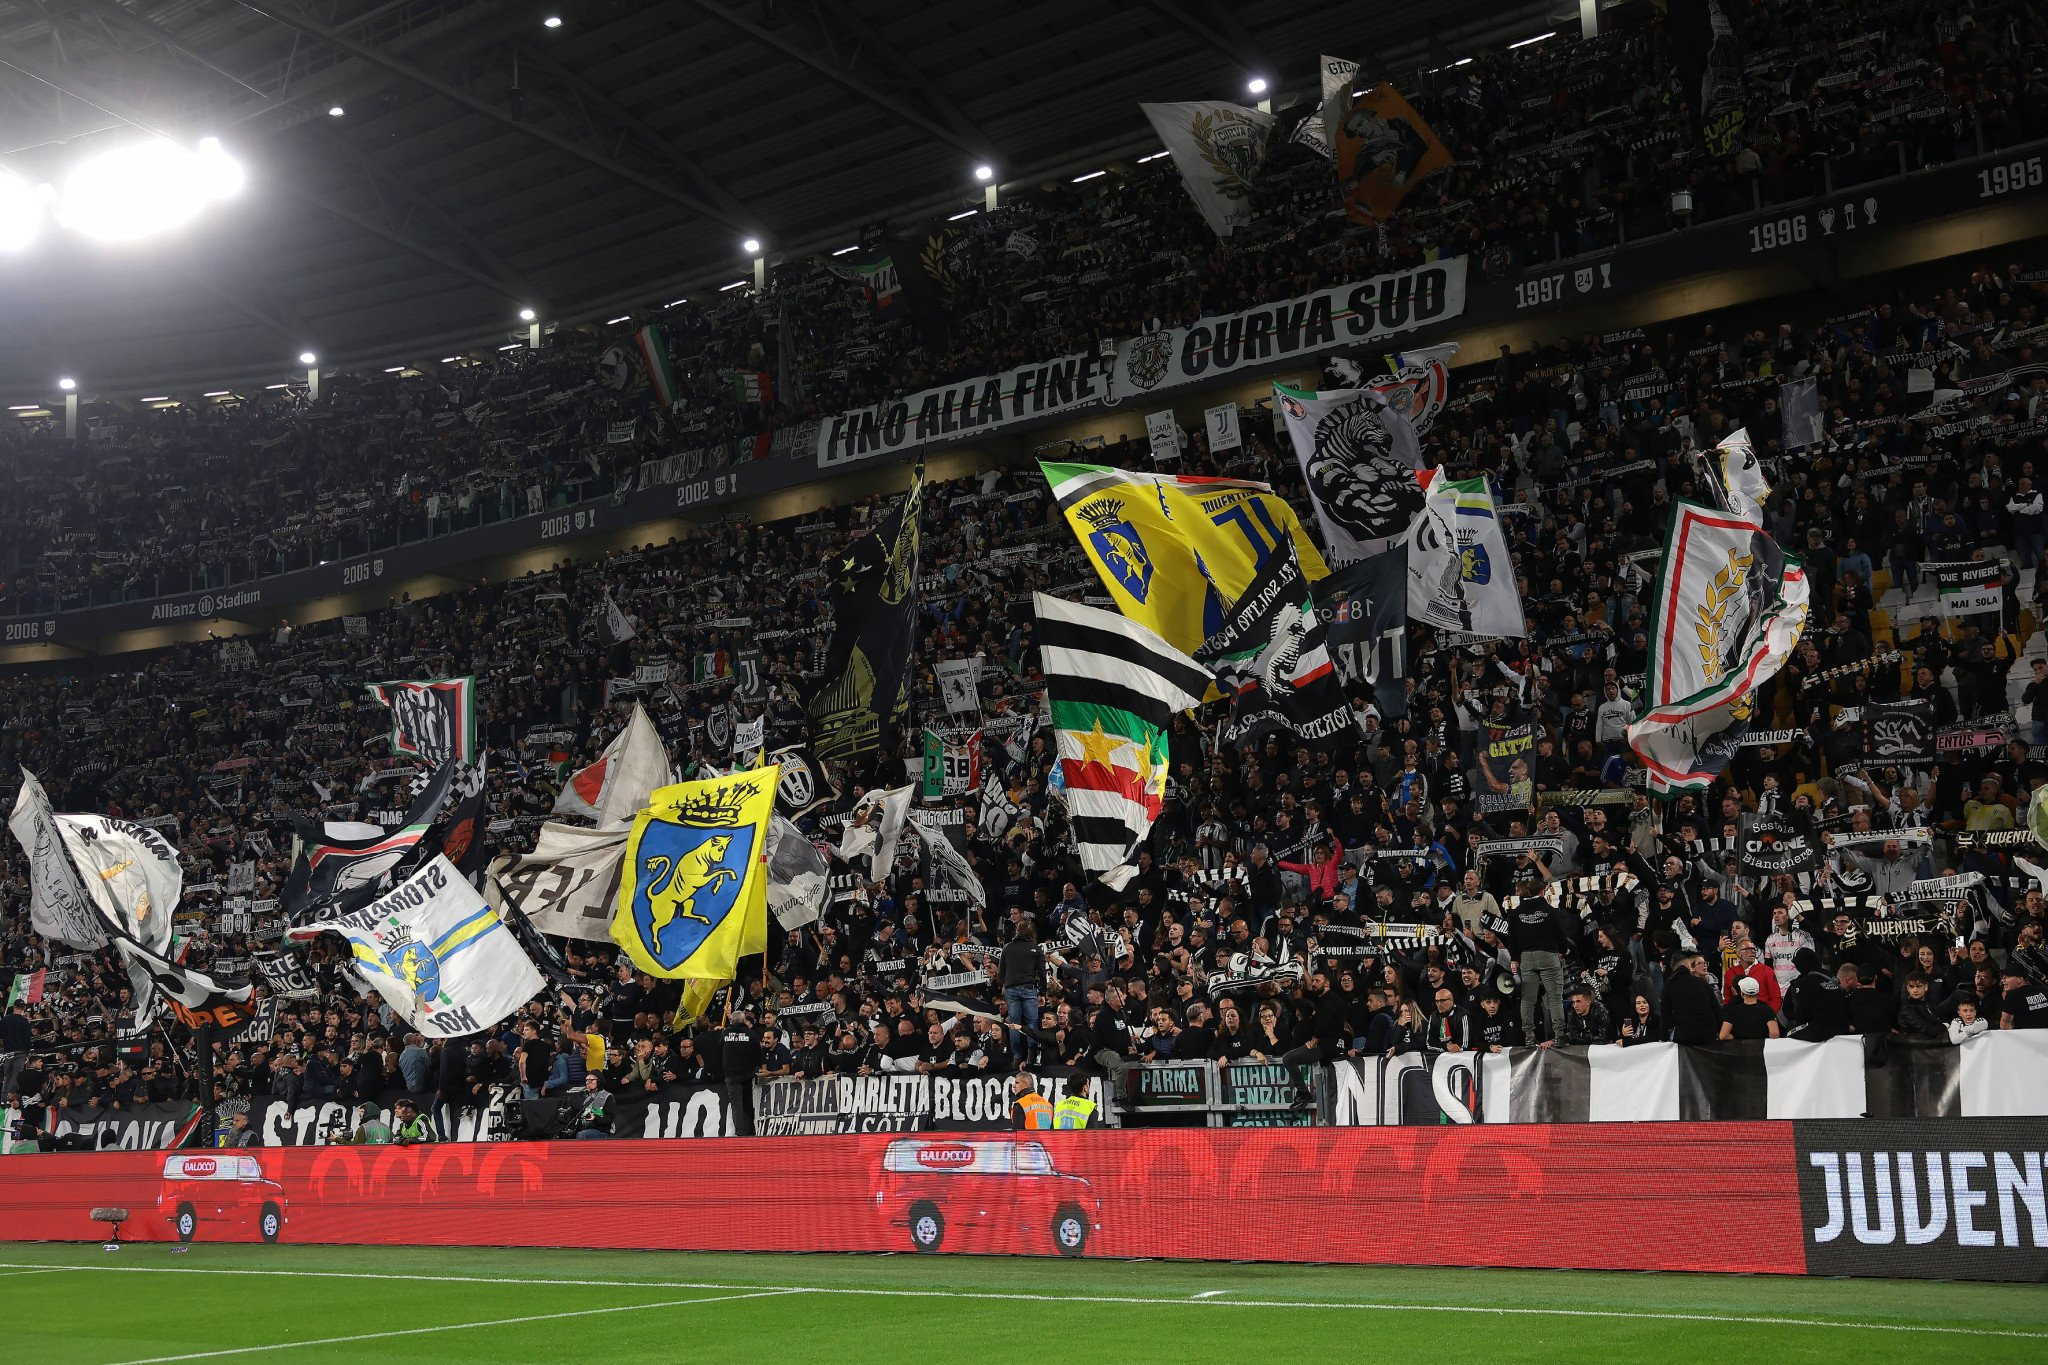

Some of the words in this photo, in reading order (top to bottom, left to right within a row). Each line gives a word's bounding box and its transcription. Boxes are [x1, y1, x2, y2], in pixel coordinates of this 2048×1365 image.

[1977, 157, 2043, 198] 1995
[1749, 215, 1807, 253] 1996
[1514, 274, 1565, 309] 1997
[1576, 275, 1592, 288] 24
[1181, 293, 1335, 376] CURVA
[1347, 267, 1447, 338] SUD
[1689, 346, 1718, 357] JUVENTUS
[827, 402, 908, 461] FINO
[915, 378, 1003, 441] ALLA
[1012, 350, 1099, 417] FINE
[677, 480, 710, 507] 2002
[716, 480, 725, 491] 26
[542, 515, 571, 539] 2003
[343, 564, 376, 586] 2005
[1940, 572, 1958, 583] DUE
[1962, 565, 1999, 581] RIVIERE
[152, 602, 196, 620] Allianz
[216, 590, 262, 610] Stadium
[1951, 599, 1969, 610] MAI
[1975, 596, 1998, 608] SOLA
[6, 622, 39, 640] 2006
[45, 621, 55, 632] 29
[1752, 821, 1795, 835] Sestola
[1485, 842, 1515, 851] MICHEL
[1521, 840, 1555, 849] PLATINI
[1742, 848, 1814, 870] Bianconera
[1866, 919, 1926, 936] JUVENTUS
[1327, 946, 1355, 956] YOUTH.
[1355, 945, 1378, 956] SINCE
[1774, 950, 1792, 961] Jeep
[876, 959, 906, 972] JUVENTUS
[1141, 1068, 1199, 1094] PARMA
[758, 1079, 838, 1115] ANDRIA
[840, 1074, 930, 1114] BARLETTA
[920, 1150, 973, 1162] BALOCCO
[184, 1160, 216, 1175] BALOCCO
[1809, 1151, 2048, 1248] JUVEN
